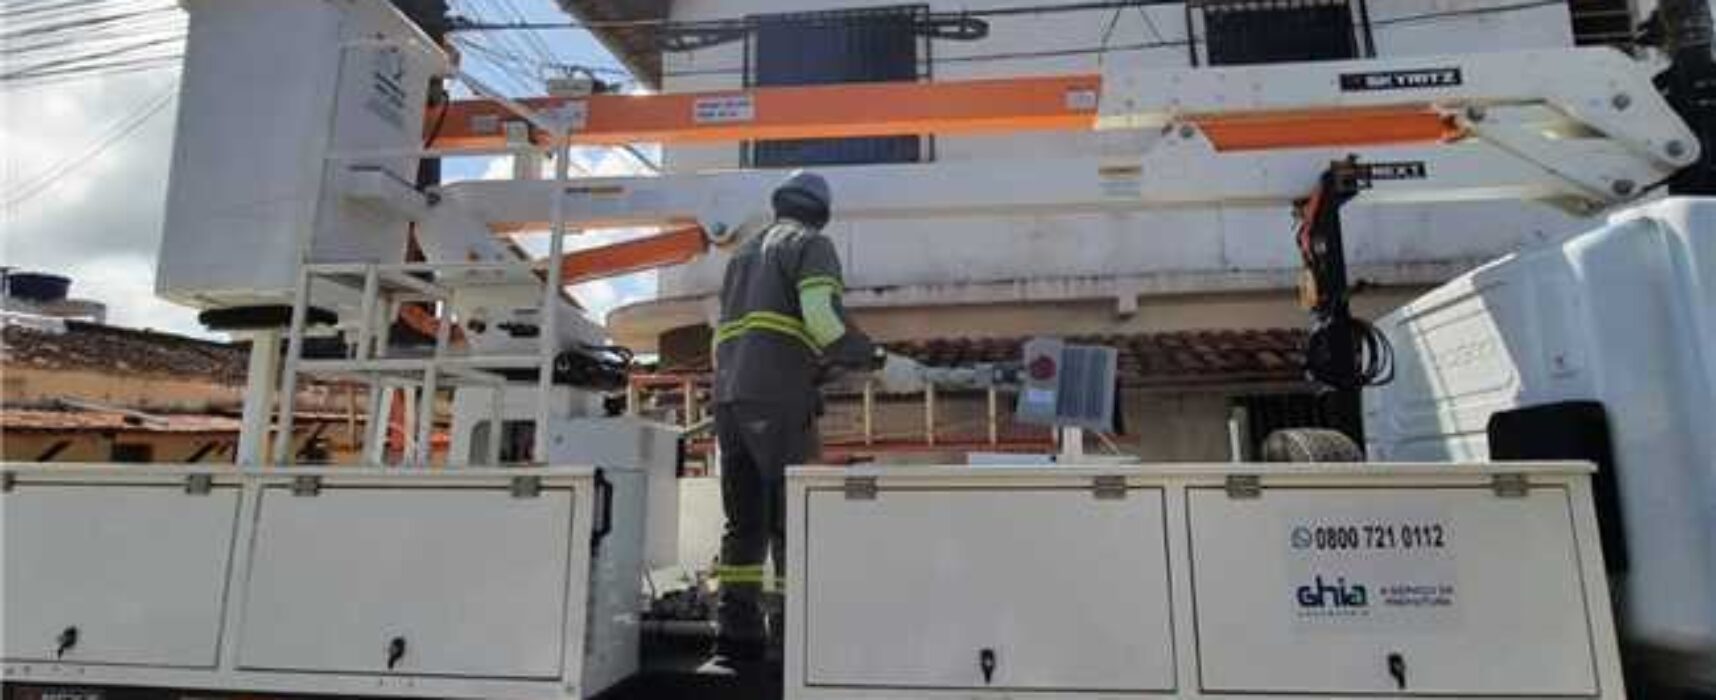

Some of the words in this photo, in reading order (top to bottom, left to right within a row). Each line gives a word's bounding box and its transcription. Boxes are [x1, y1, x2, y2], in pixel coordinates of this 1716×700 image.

[1315, 527, 1359, 549] 0800
[1362, 525, 1396, 548] 721
[1401, 524, 1445, 547] 0112
